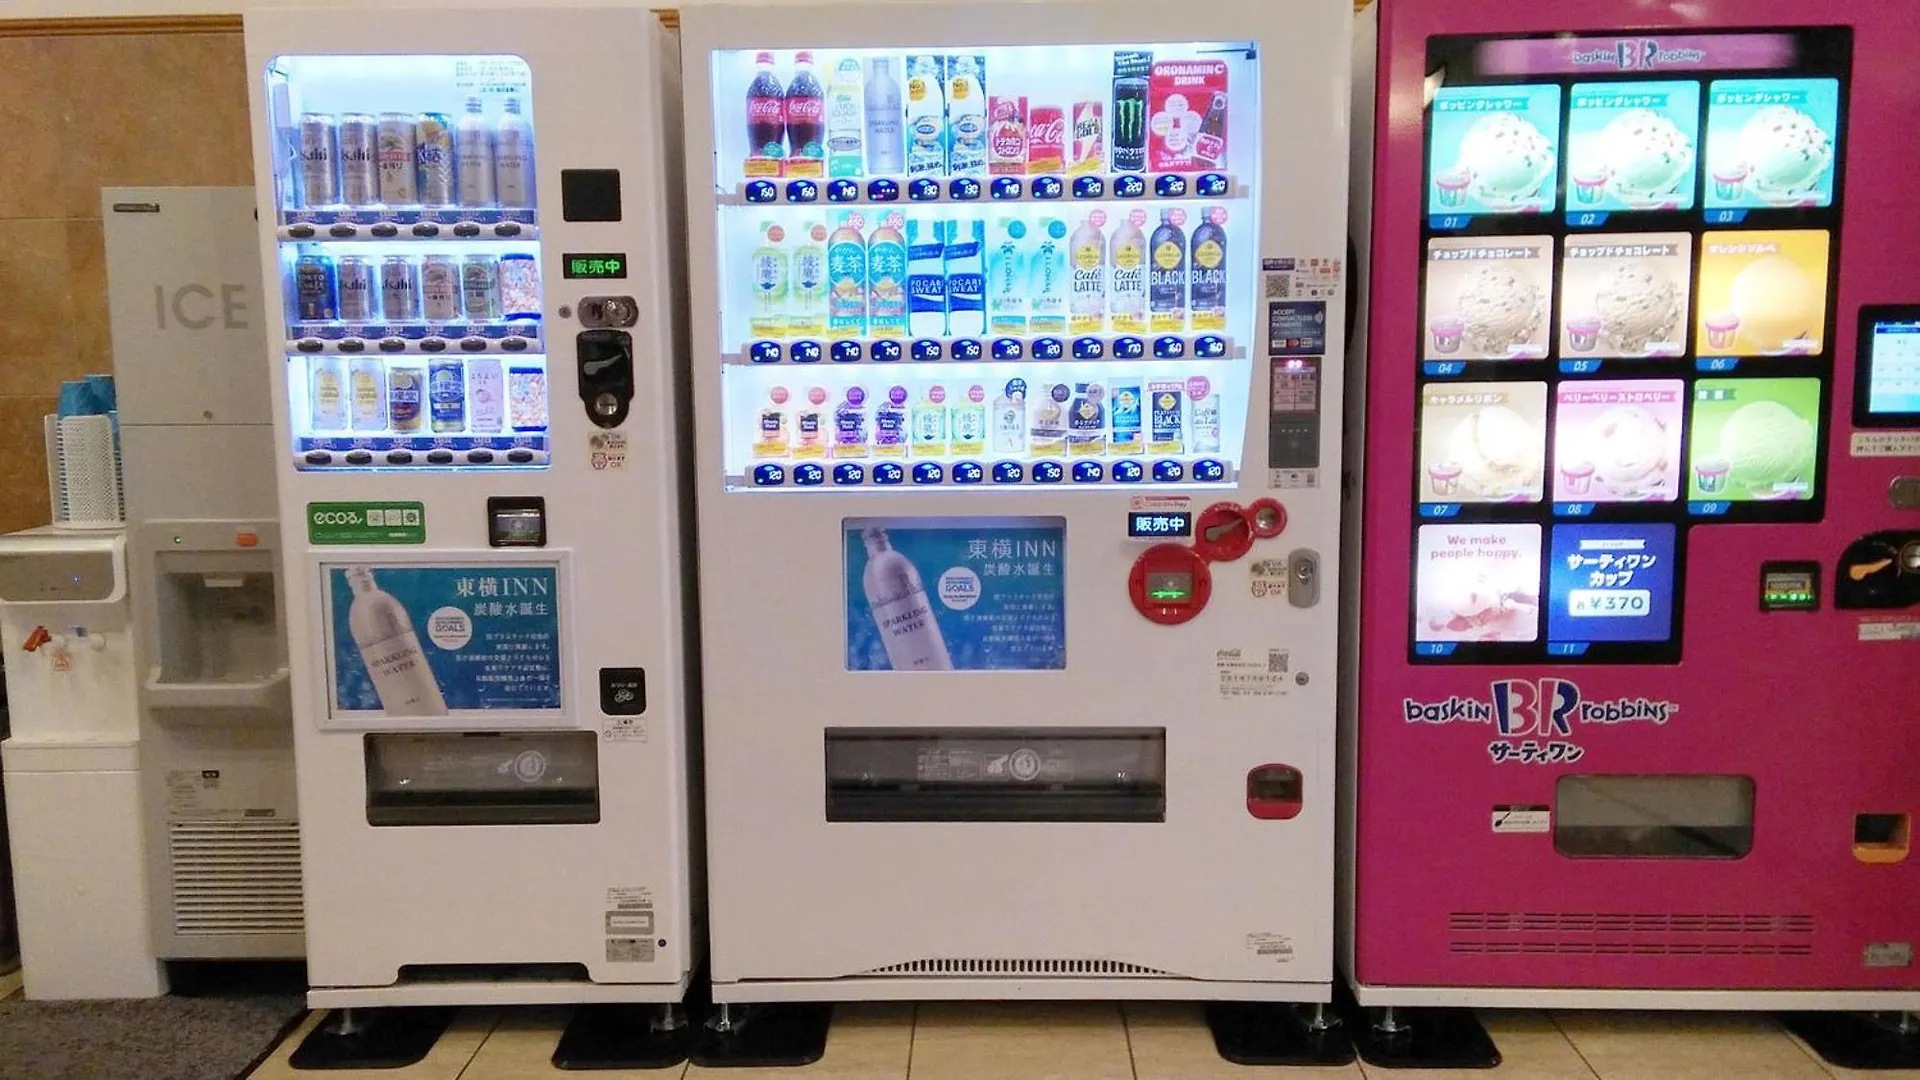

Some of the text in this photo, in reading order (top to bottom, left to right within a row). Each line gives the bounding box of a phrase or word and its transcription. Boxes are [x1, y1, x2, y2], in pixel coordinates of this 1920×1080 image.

[1155, 65, 1213, 75] ORONAMIN
[1214, 64, 1224, 74] C
[1174, 76, 1206, 85] DRINK
[1444, 217, 1457, 227] 01
[1581, 214, 1595, 224] 02
[1719, 211, 1734, 221] 03
[1433, 248, 1531, 259] チョップドチョコレート
[1570, 245, 1669, 257] チョップドチョコレート
[571, 259, 621, 274] 販売中
[833, 254, 863, 273] 麦茶
[872, 254, 902, 273] 麦茶
[1114, 268, 1142, 280] Café
[1151, 271, 1185, 285] BLACK
[1192, 269, 1225, 284] BLACK
[1074, 281, 1101, 292] LATTE
[1114, 281, 1142, 291] LATTE
[155, 283, 248, 330] ICE
[1438, 364, 1453, 373] 04
[1573, 361, 1588, 370] 05
[1711, 360, 1725, 369] 06
[1434, 505, 1448, 515] 07
[1568, 504, 1582, 514] 08
[1703, 503, 1717, 513] 09
[1136, 516, 1185, 532] 販売中
[1447, 534, 1506, 545] We make
[968, 539, 1056, 559] 東横INN
[1431, 548, 1522, 560] people happy.
[1567, 553, 1657, 570] サーティワン
[983, 562, 1055, 576] 炭酸水誕生
[1590, 570, 1634, 587] カップ
[456, 576, 548, 597] 東横INN
[474, 602, 549, 616] 炭酸水誕生
[1590, 597, 1644, 610] ¥370
[882, 606, 928, 630] SPARKLING
[436, 623, 465, 632] GOALS
[893, 620, 925, 636] WATER
[1431, 644, 1443, 654] 10
[1563, 644, 1576, 654] 11
[1406, 679, 1668, 735] baskin BR robbins
[1489, 742, 1583, 762] サーティワン
